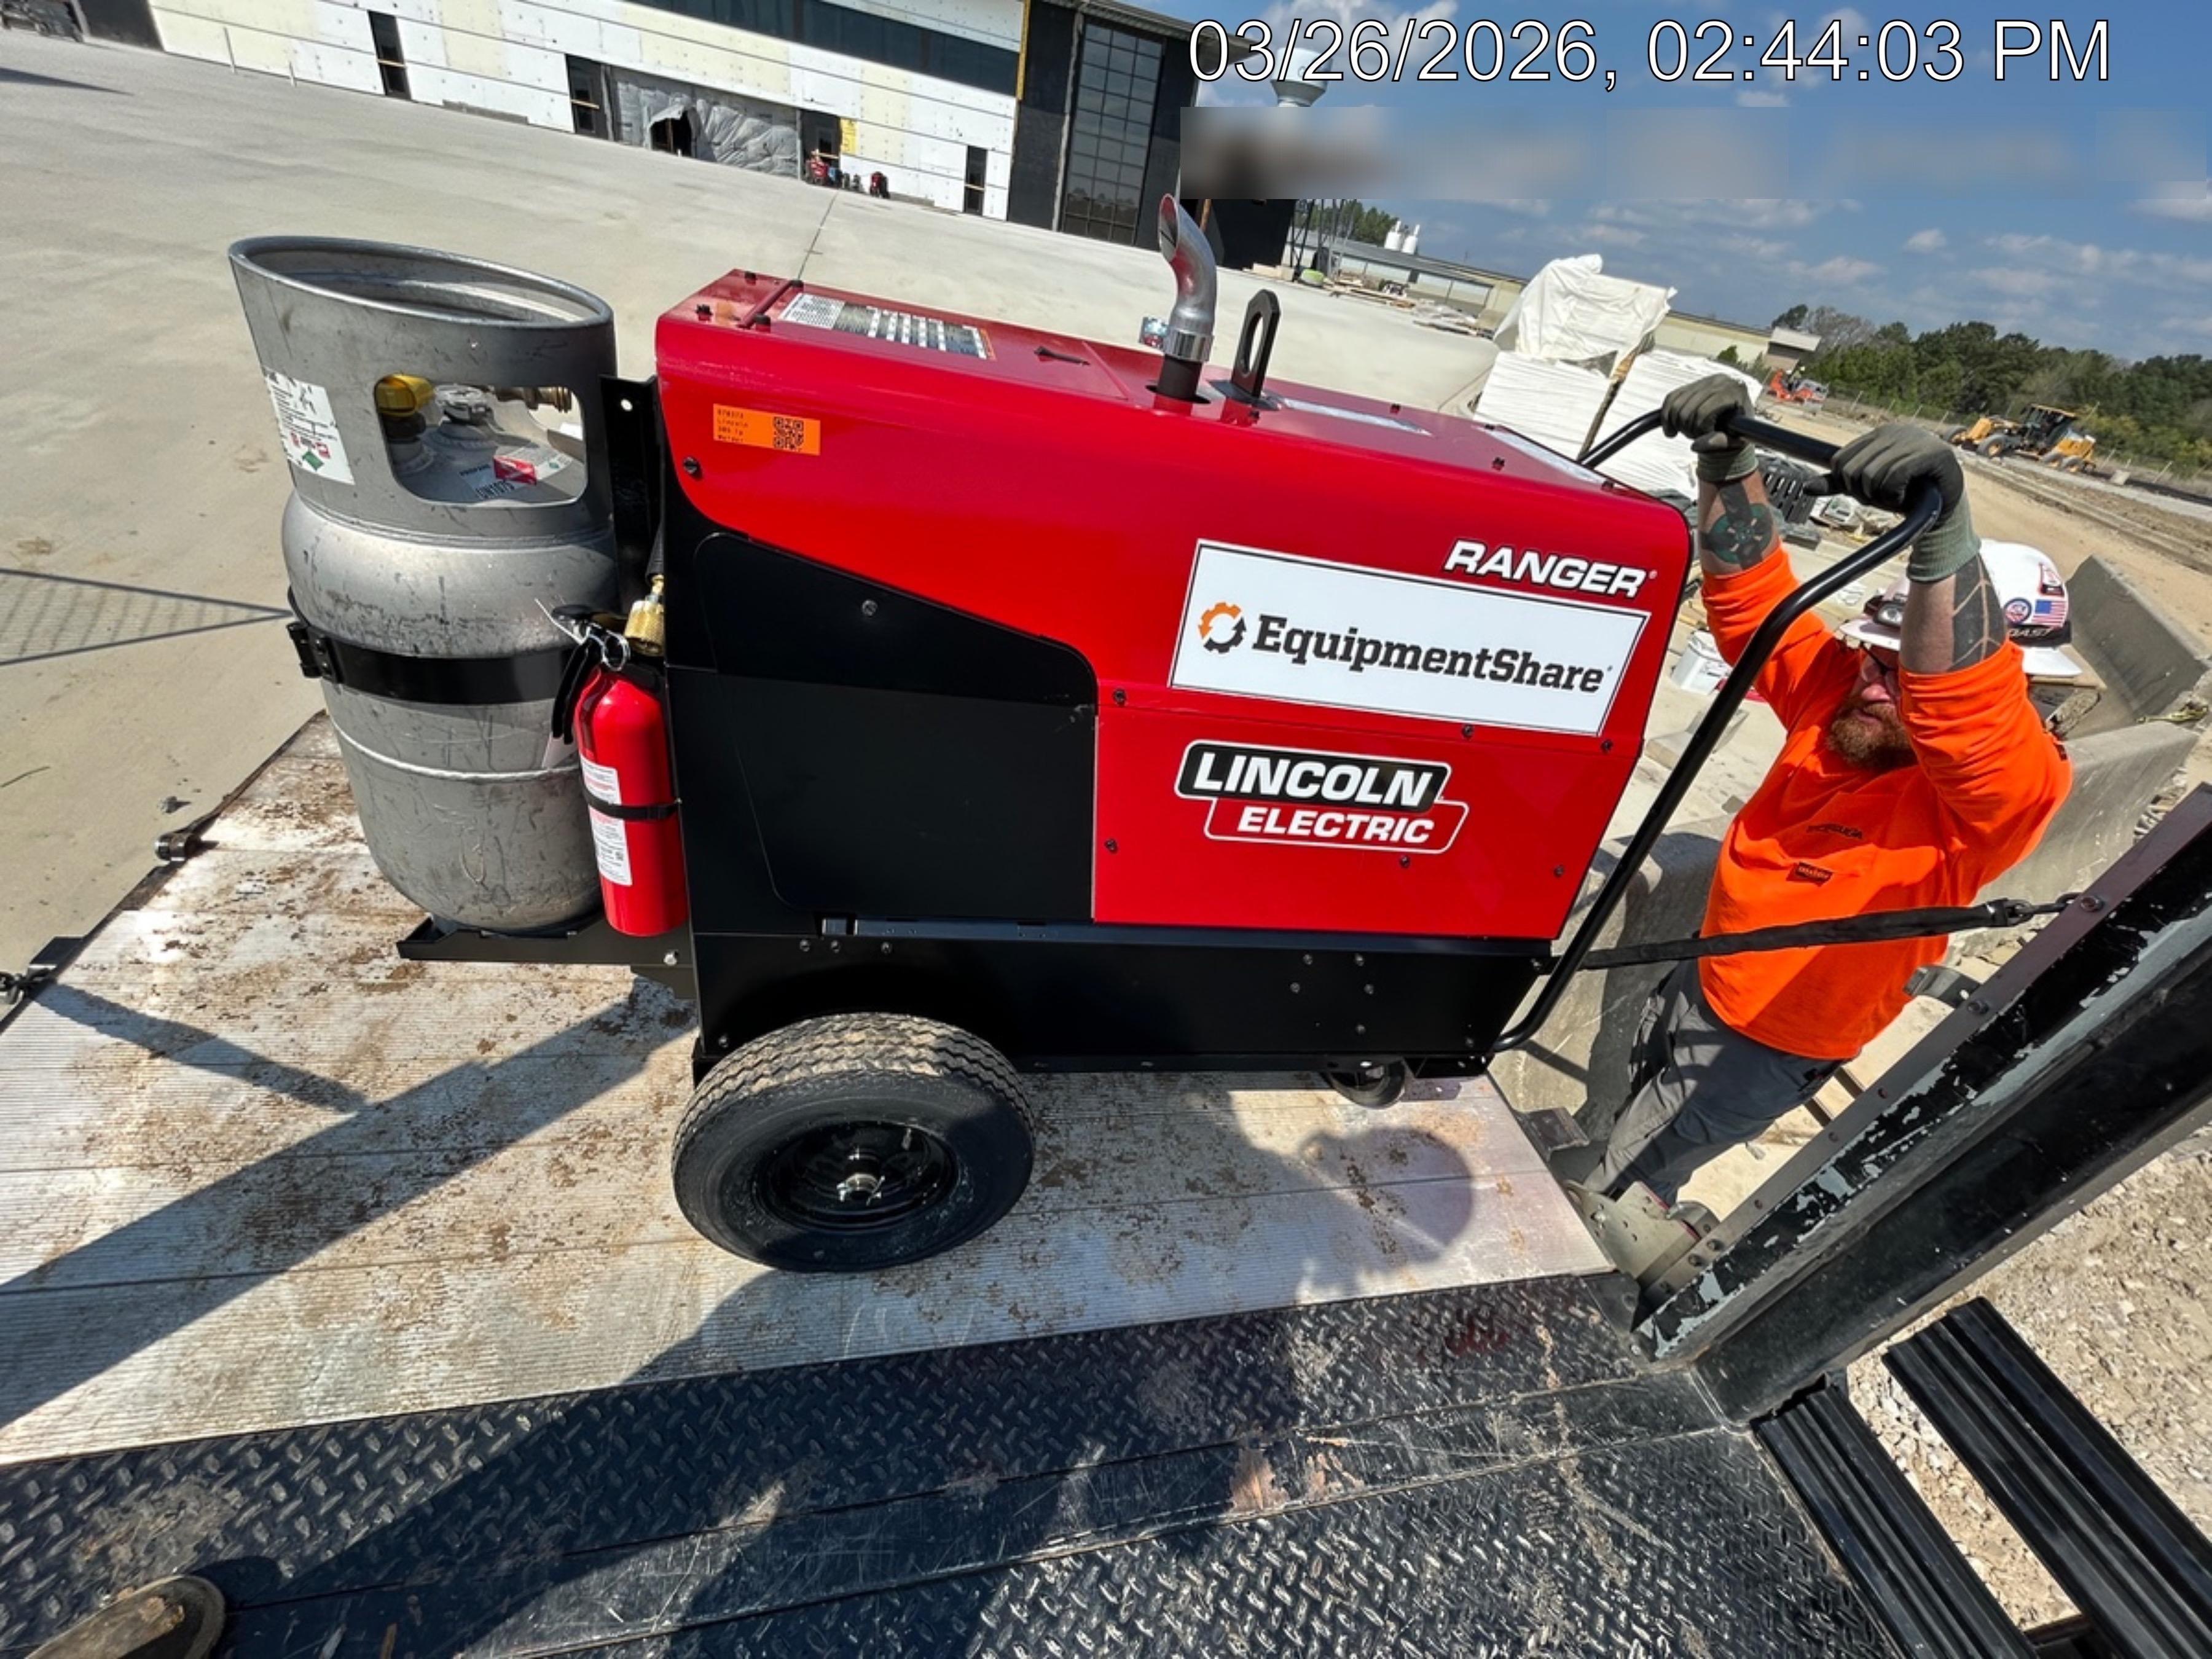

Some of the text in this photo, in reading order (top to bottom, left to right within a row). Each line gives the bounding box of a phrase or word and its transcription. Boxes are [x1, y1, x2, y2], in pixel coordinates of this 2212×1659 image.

[1444, 539, 1647, 598] RANGER
[1253, 614, 1604, 693] EquipmentShare
[1193, 751, 1434, 807] LINCOLN
[1237, 805, 1436, 844] ELECTRIC
